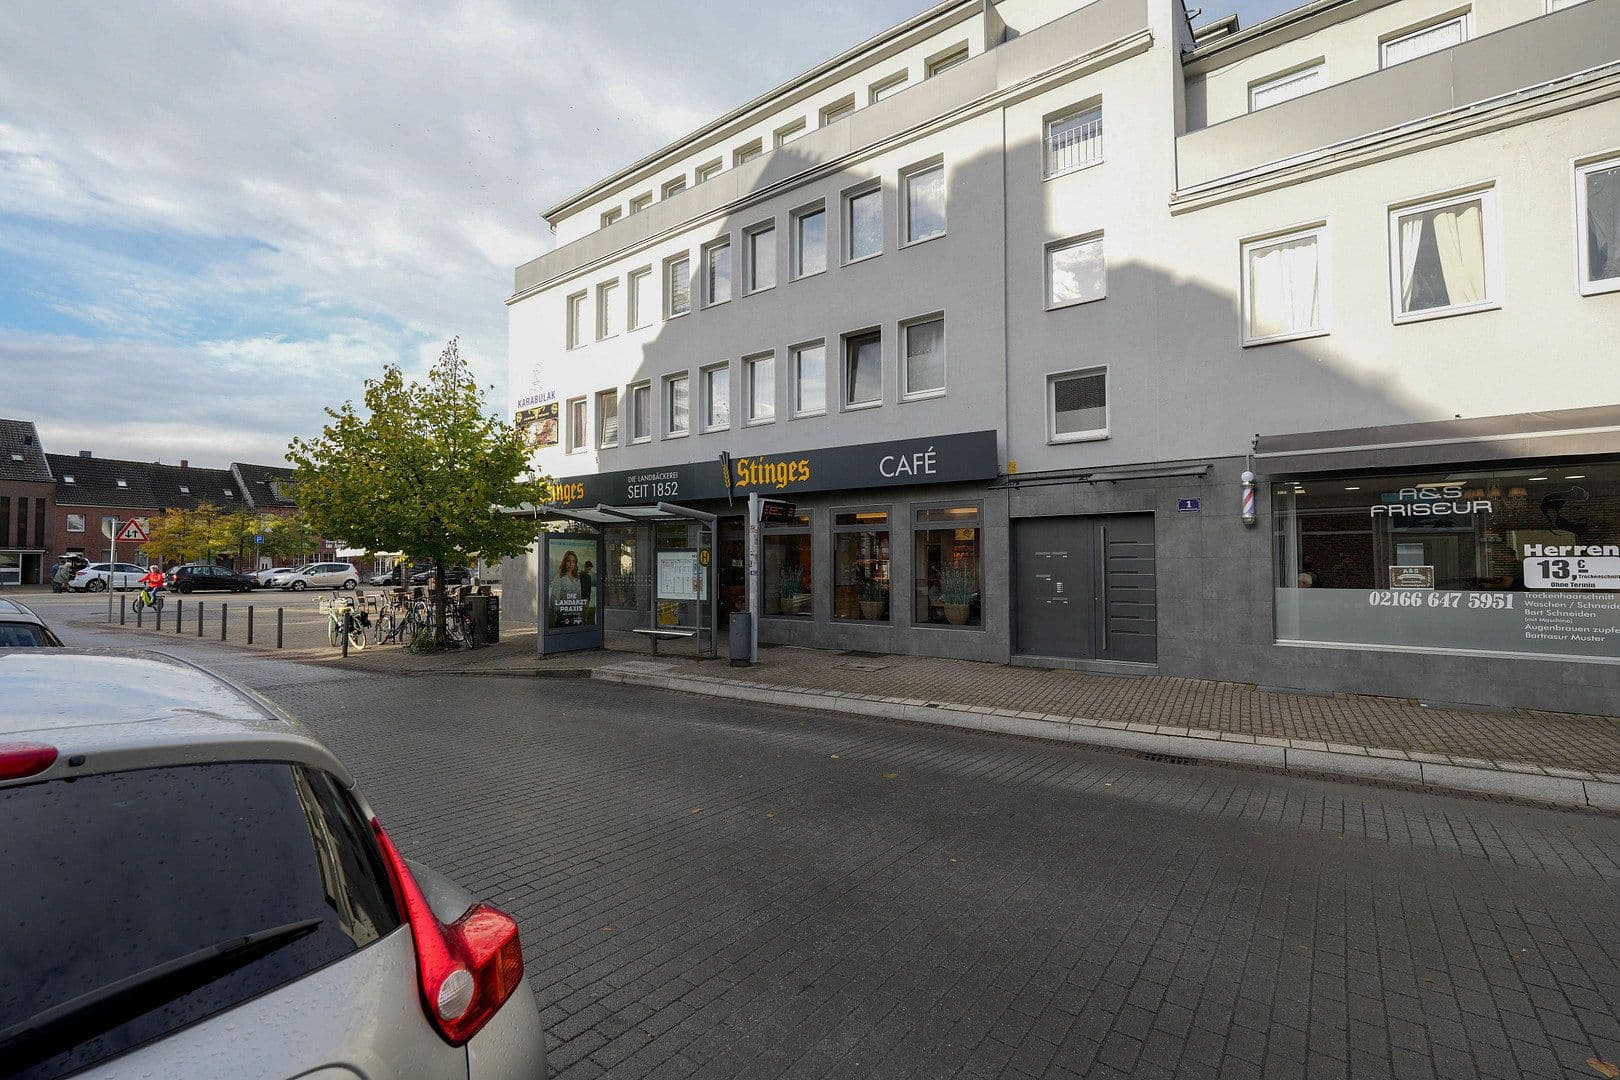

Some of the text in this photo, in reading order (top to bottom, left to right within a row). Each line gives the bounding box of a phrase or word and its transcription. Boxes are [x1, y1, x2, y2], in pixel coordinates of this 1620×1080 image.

[517, 390, 556, 409] KARABULAK
[879, 446, 937, 477] CAFÉ
[627, 475, 637, 483] DIE
[736, 456, 811, 489] Stinges
[627, 481, 678, 499] SEIT 1852
[1399, 486, 1462, 500] A&S
[1370, 500, 1493, 518] FRISEUR
[1523, 543, 1620, 557] Herren
[1369, 591, 1514, 610] 02166 647 5951
[1524, 592, 1615, 600] Trockenhaarschnitt
[1524, 600, 1566, 608] Waschen
[1525, 608, 1597, 618] Bart Schneiden
[1524, 623, 1590, 633] Augenbrauen
[1525, 632, 1606, 642] Bartrasur Muster
